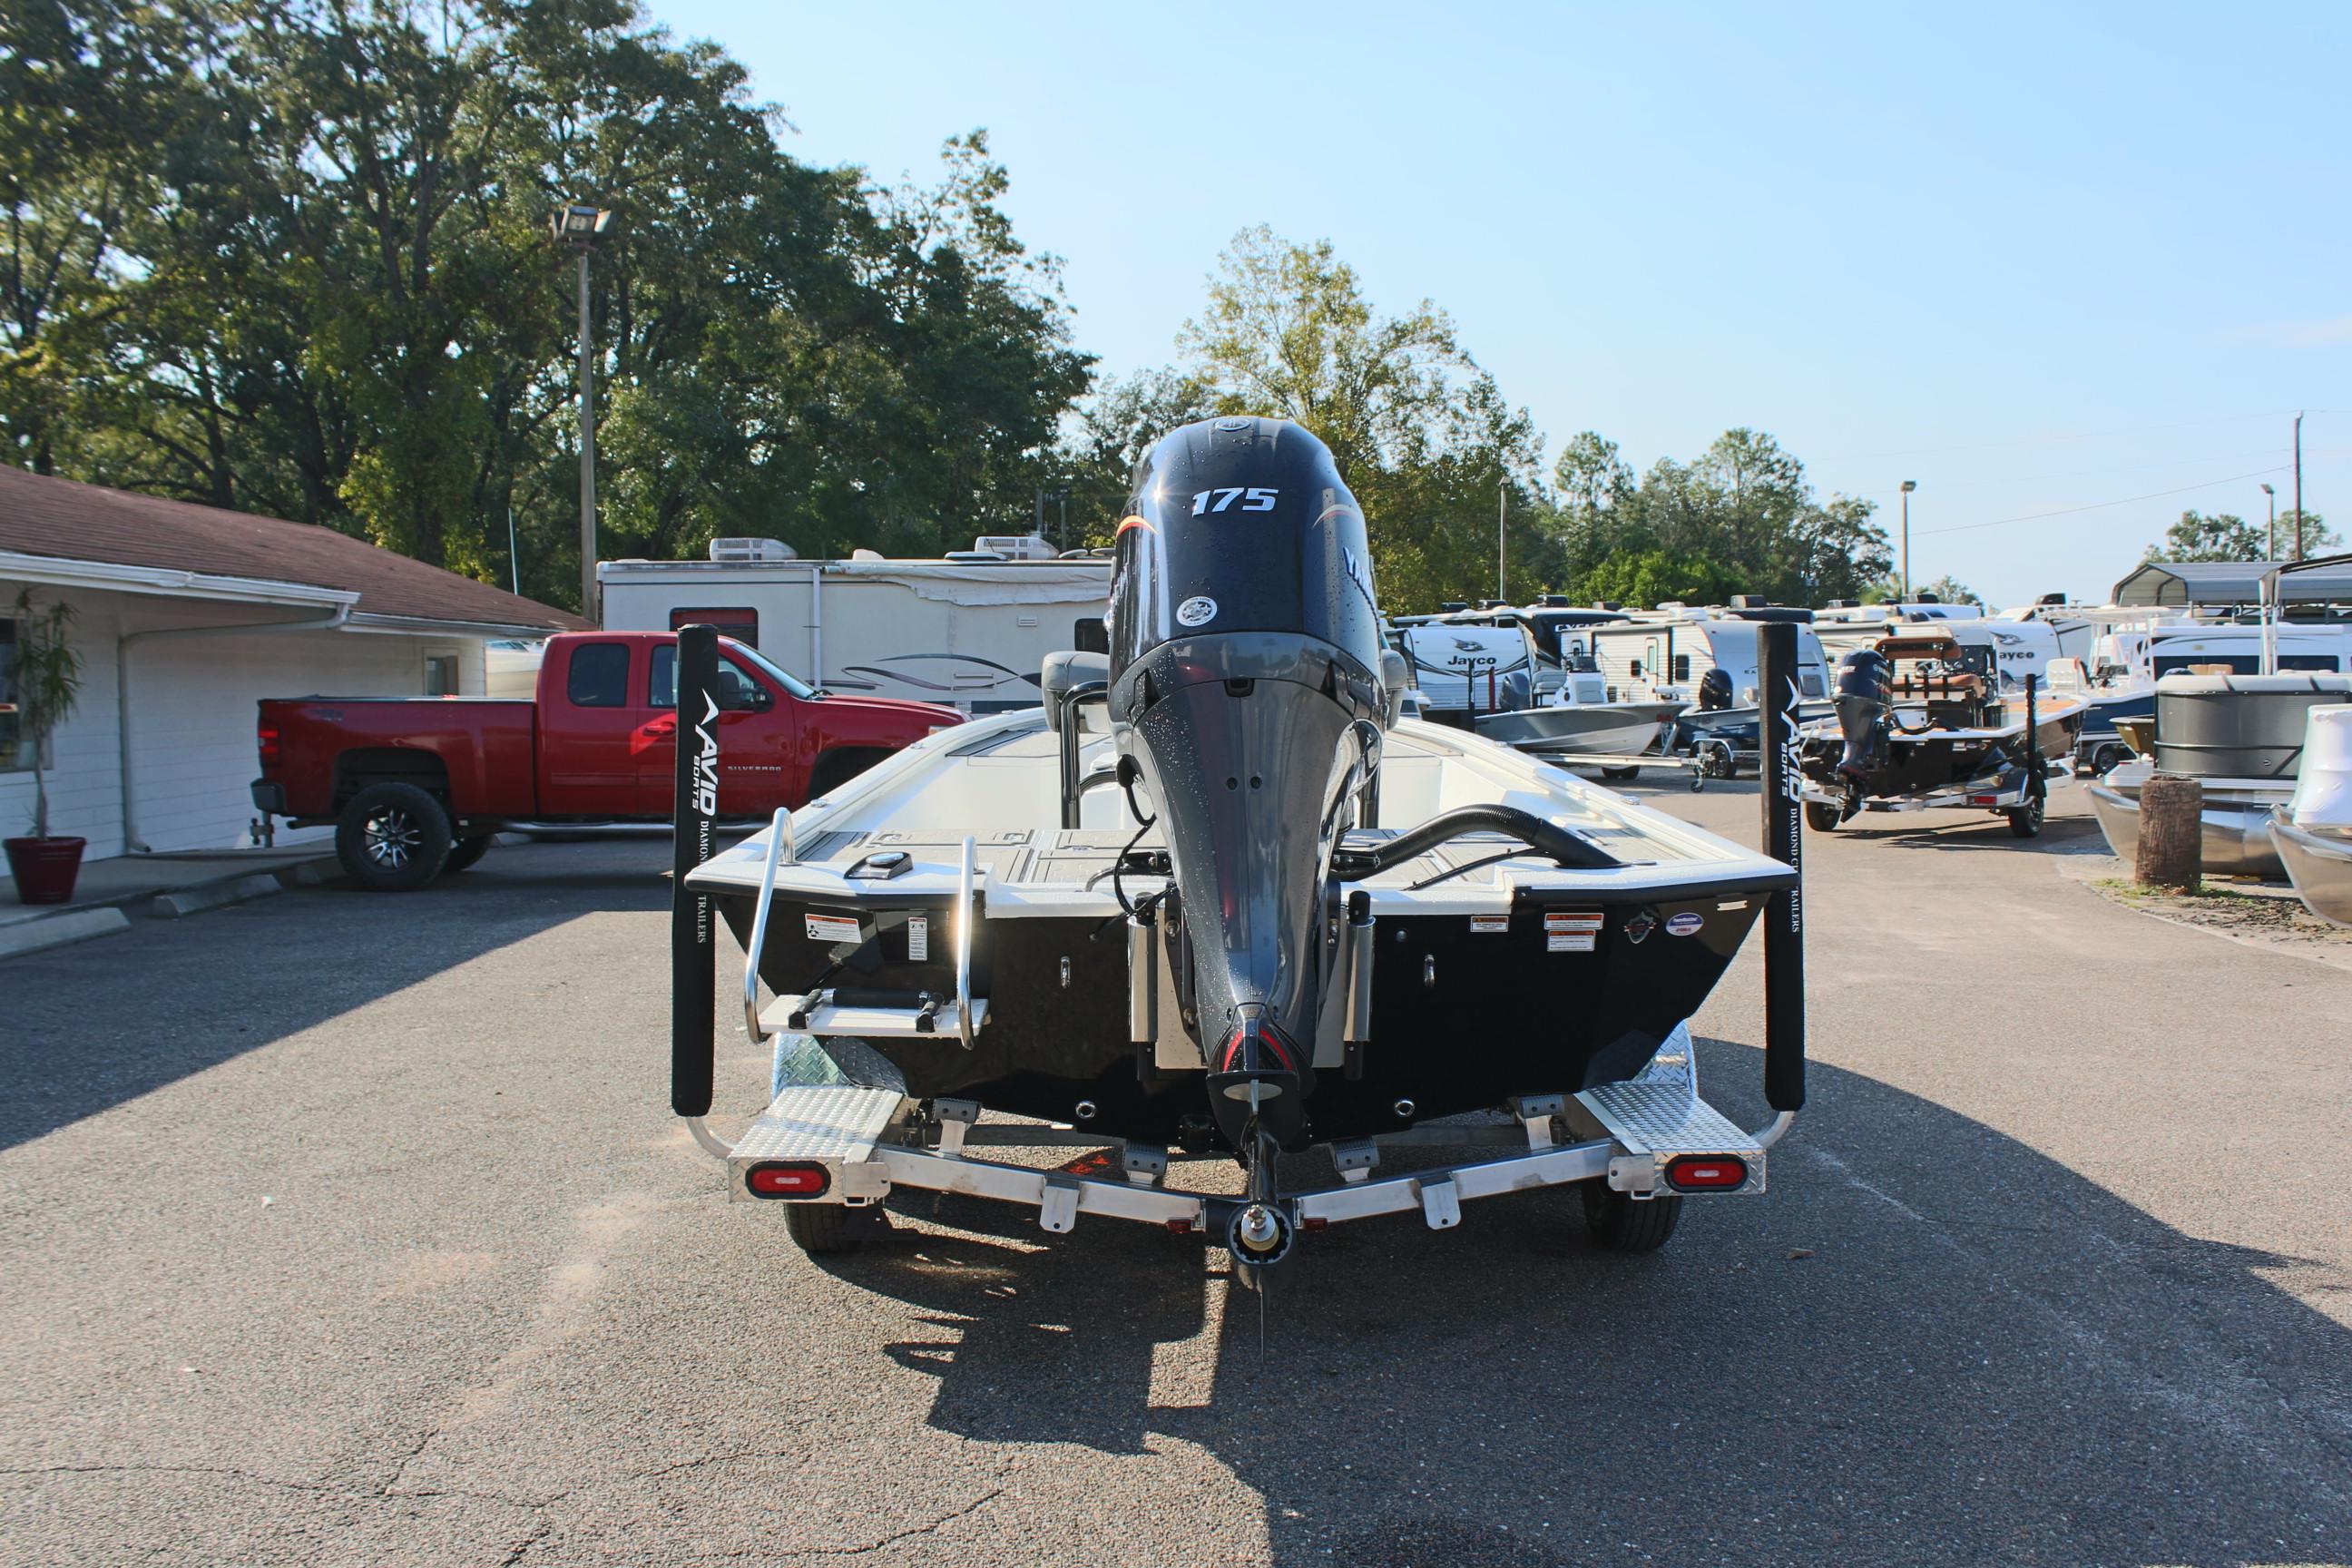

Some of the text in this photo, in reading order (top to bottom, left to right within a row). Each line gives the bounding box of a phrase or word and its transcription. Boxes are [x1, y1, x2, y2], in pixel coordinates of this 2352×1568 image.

[1192, 487, 1279, 517] 175
[1447, 655, 1496, 666] Jayco
[1999, 652, 2034, 661] ayco
[692, 755, 701, 809] BOATS
[1780, 711, 1801, 803] AVID
[1780, 742, 1788, 798] BOATS
[695, 724, 718, 944] AVID DIAMON TRAILERS
[1790, 808, 1798, 856] DIAMOND
